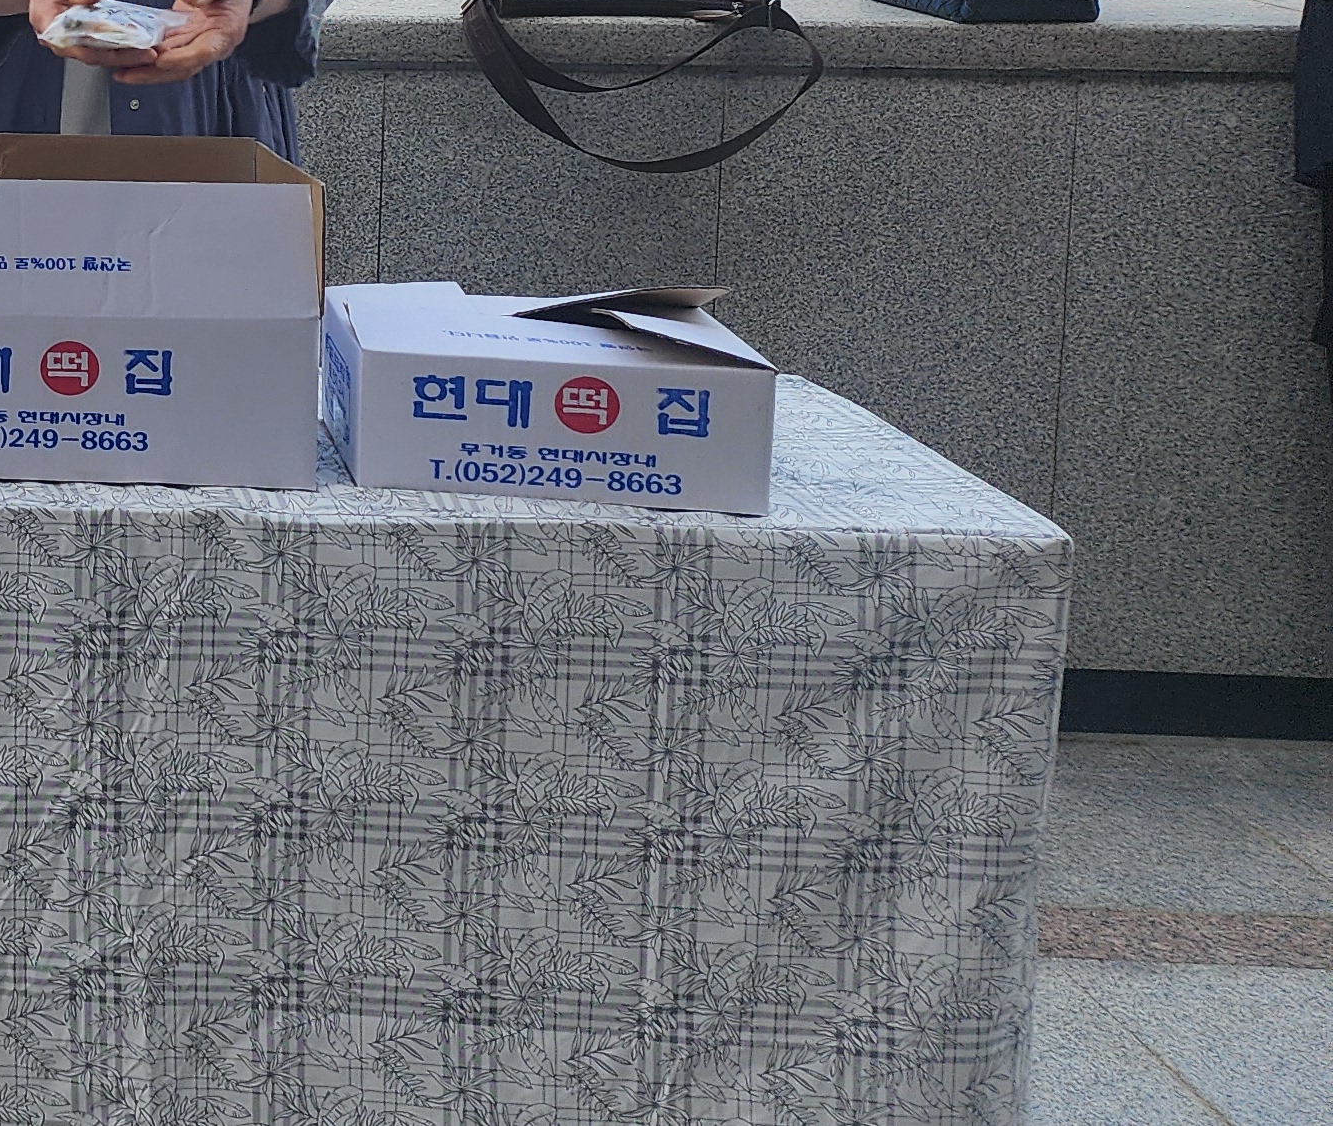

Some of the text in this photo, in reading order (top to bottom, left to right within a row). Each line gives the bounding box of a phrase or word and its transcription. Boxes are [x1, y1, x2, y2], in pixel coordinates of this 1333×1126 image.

[14, 257, 77, 271] 100%로
[82, 256, 132, 272] 국산쌀
[46, 350, 90, 388] 떡
[123, 350, 172, 396] 집
[18, 410, 125, 426] 현대시장내
[413, 374, 710, 437] 현대 떡 집
[459, 442, 657, 468] 무거동 현대시장내
[429, 458, 682, 495] T.(052)249-8663
